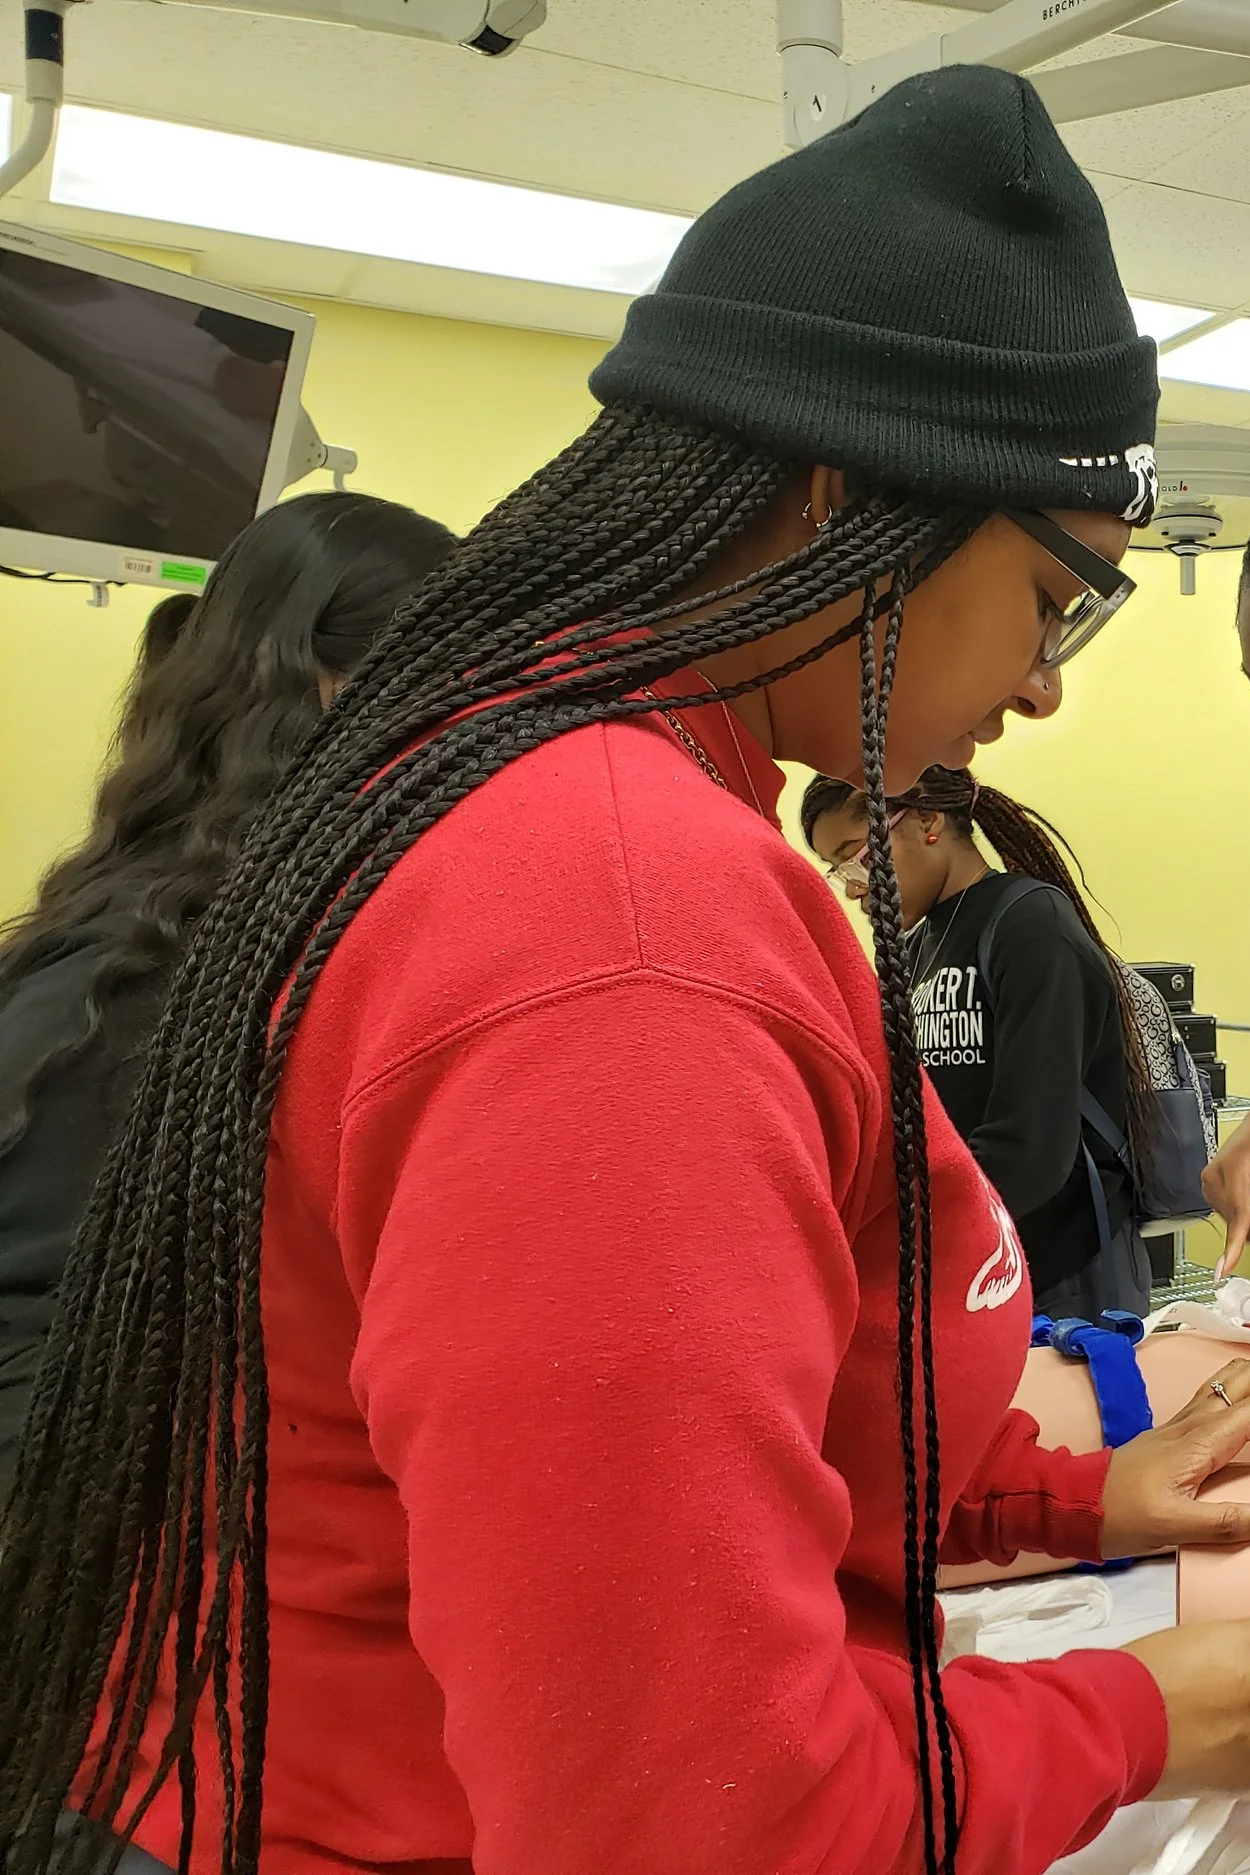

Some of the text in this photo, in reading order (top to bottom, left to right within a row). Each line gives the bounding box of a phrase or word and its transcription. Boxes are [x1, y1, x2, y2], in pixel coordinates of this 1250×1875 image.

[911, 966, 982, 1015] OOKER T.
[915, 1010, 983, 1049] HINGTON
[922, 1048, 986, 1066] SCHOOL
